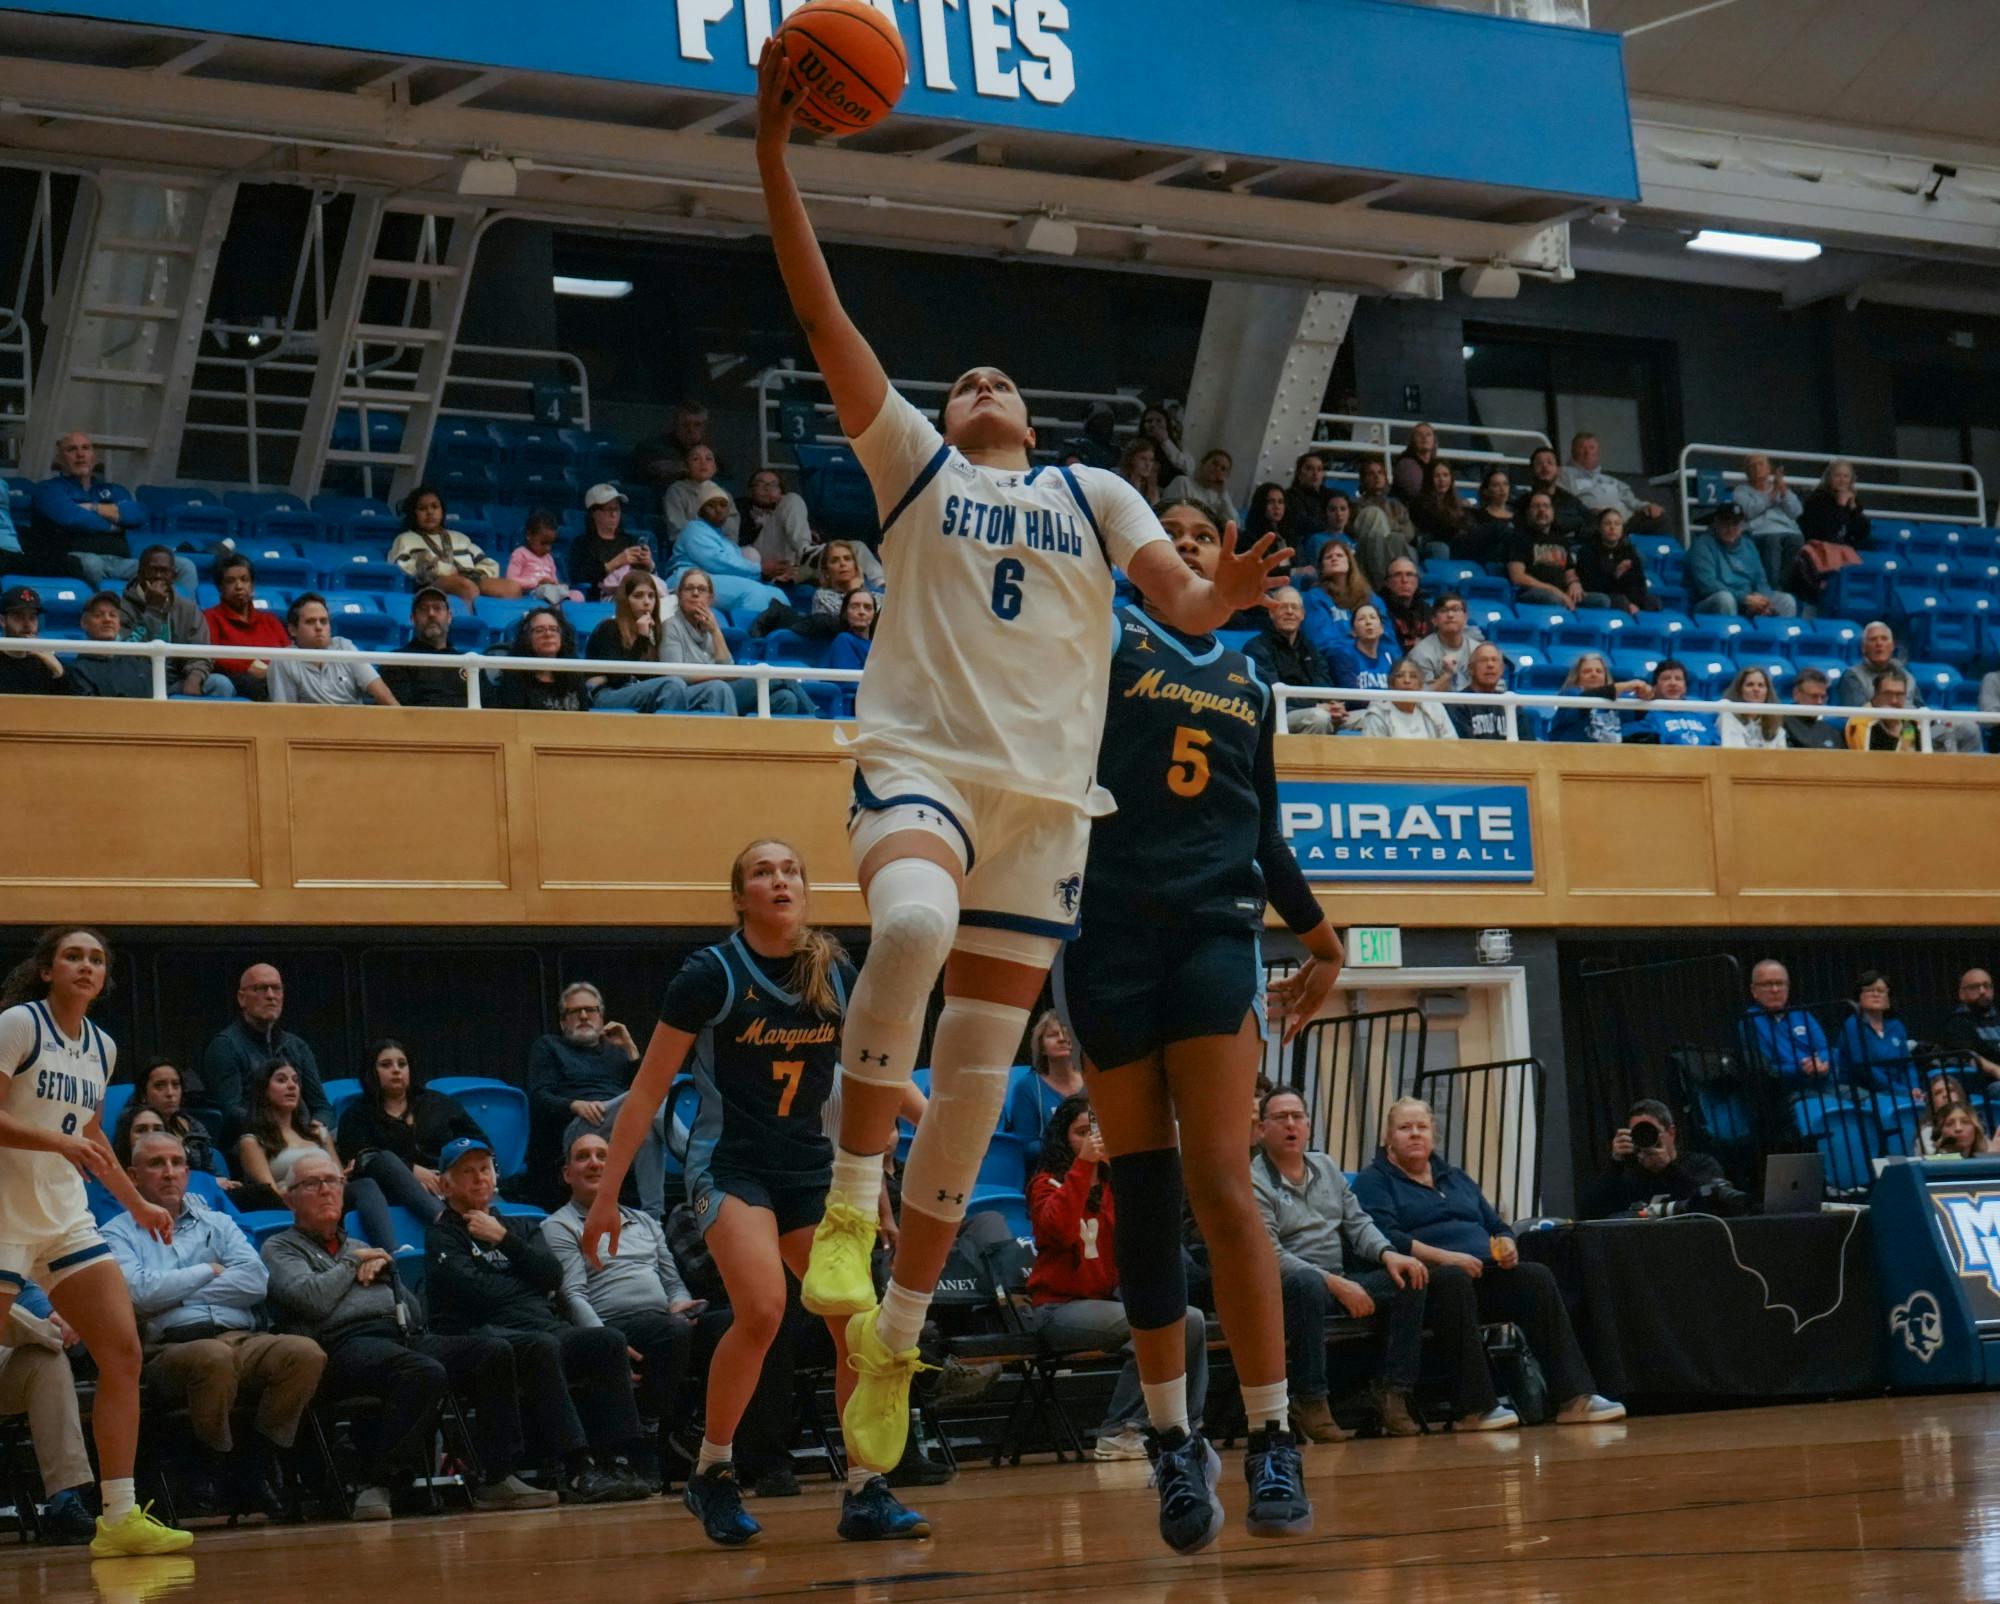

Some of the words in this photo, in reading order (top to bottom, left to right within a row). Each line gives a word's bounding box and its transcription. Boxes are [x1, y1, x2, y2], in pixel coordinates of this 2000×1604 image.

[677, 0, 1075, 104] PITES
[797, 48, 872, 121] Wilson
[547, 399, 560, 421] 4
[792, 415, 805, 438] 3
[1706, 483, 1717, 503] 2
[942, 494, 1016, 545] SETON
[1024, 509, 1082, 558] HALL
[991, 557, 1025, 621] 6
[1123, 667, 1257, 727] Marquette
[1167, 725, 1212, 798] 5
[1280, 803, 1514, 841] PIRATE
[1360, 930, 1392, 962] EXIT
[735, 1016, 836, 1052] Marquette
[36, 1069, 78, 1105] SETON
[772, 1060, 805, 1117] 7
[936, 1278, 977, 1291] ANEY
